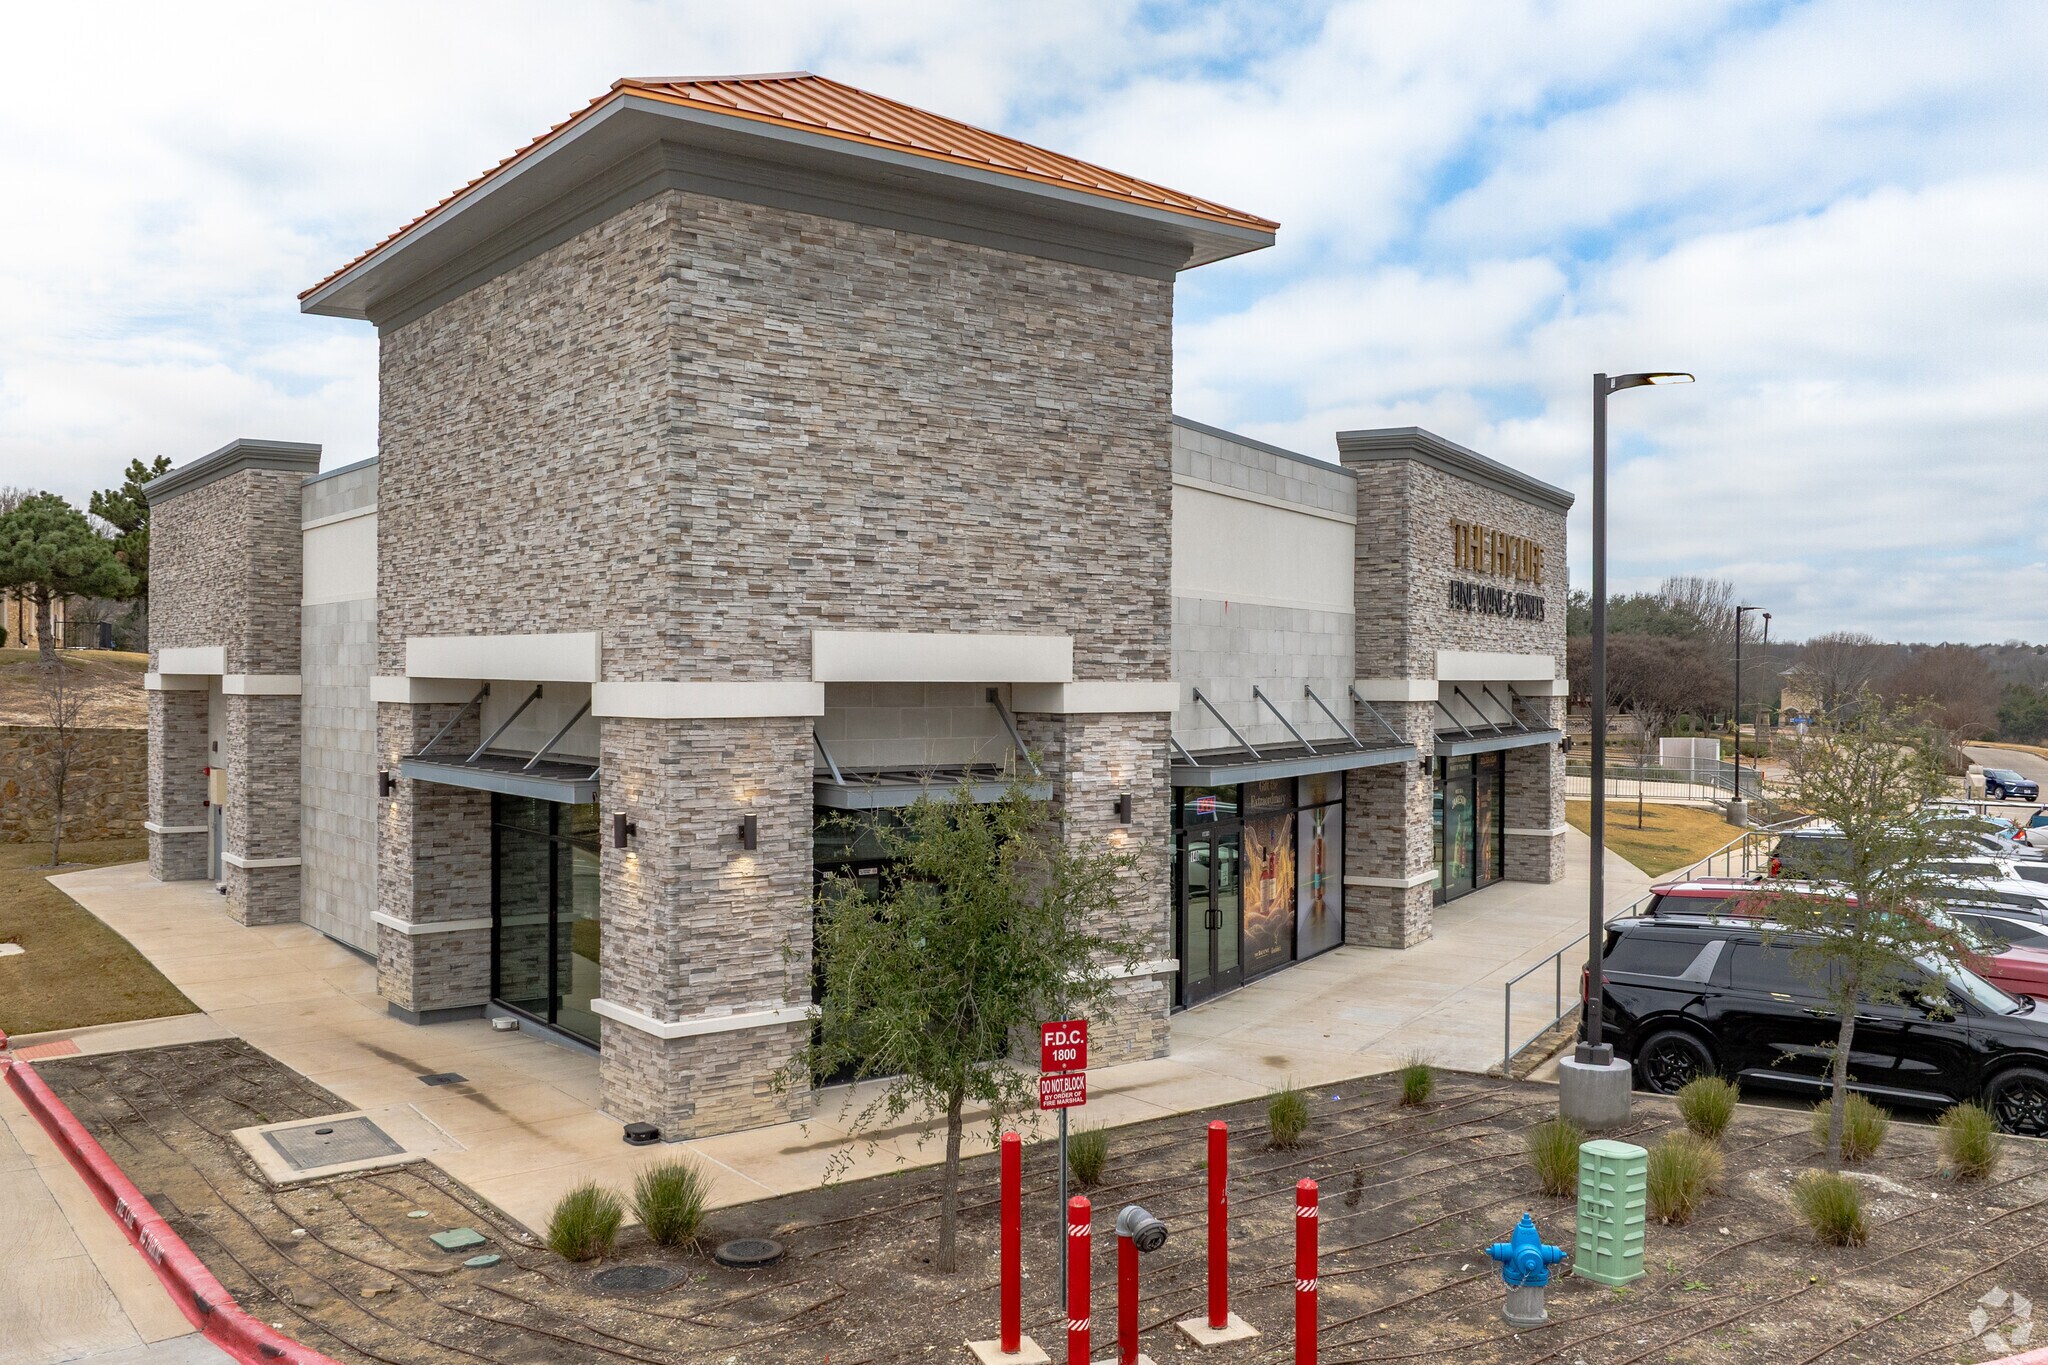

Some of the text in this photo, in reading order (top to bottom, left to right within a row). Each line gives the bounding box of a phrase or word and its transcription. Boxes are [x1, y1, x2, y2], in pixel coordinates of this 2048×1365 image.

[1449, 518, 1490, 574] THE
[1450, 580, 1545, 621] FINE WINE & SPIRITS
[1044, 1030, 1084, 1047] F.D.C.
[1052, 1048, 1077, 1061] 1800
[1042, 1076, 1085, 1094] DO NOT BLOCK
[1056, 1097, 1084, 1105] MARSHAL
